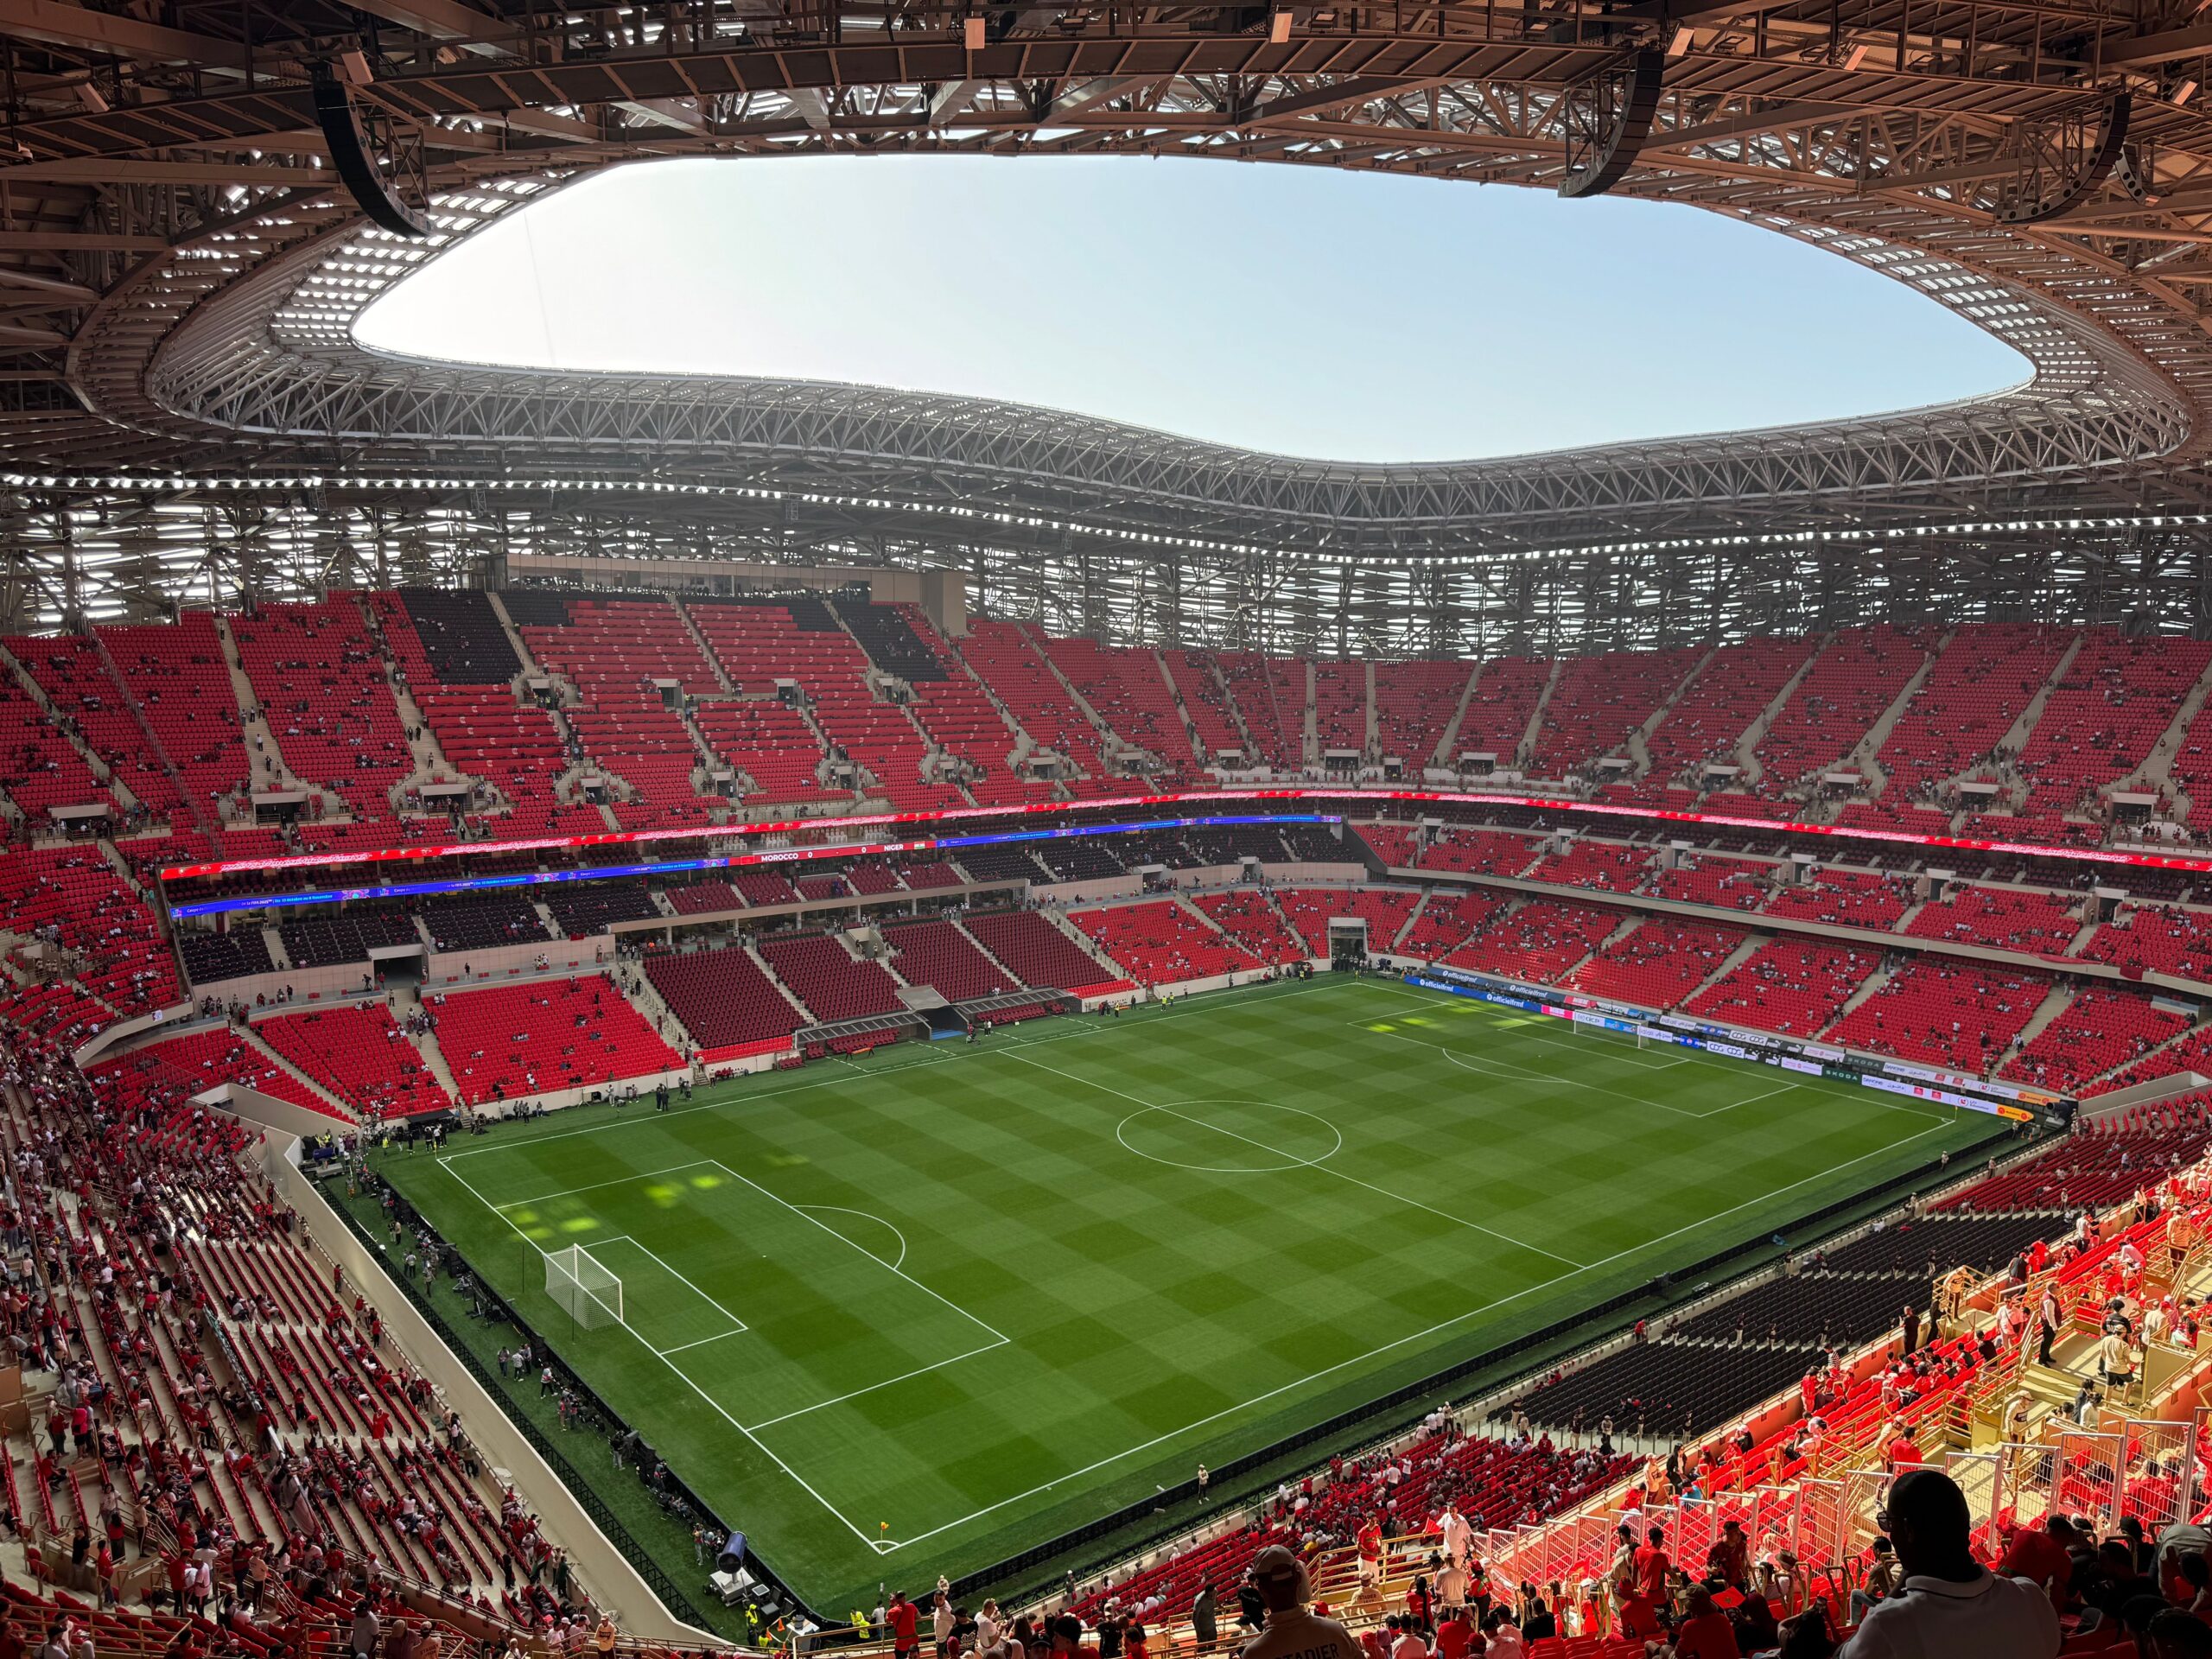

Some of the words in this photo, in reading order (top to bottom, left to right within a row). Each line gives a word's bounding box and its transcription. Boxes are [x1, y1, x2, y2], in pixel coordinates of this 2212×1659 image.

[761, 852, 799, 862] MOROCCO
[884, 843, 904, 852] NIGER
[1732, 1031, 1746, 1040] CDG
[1749, 1035, 1764, 1044] CDG
[1709, 1043, 1724, 1052] CDG
[1727, 1047, 1742, 1057] CDG
